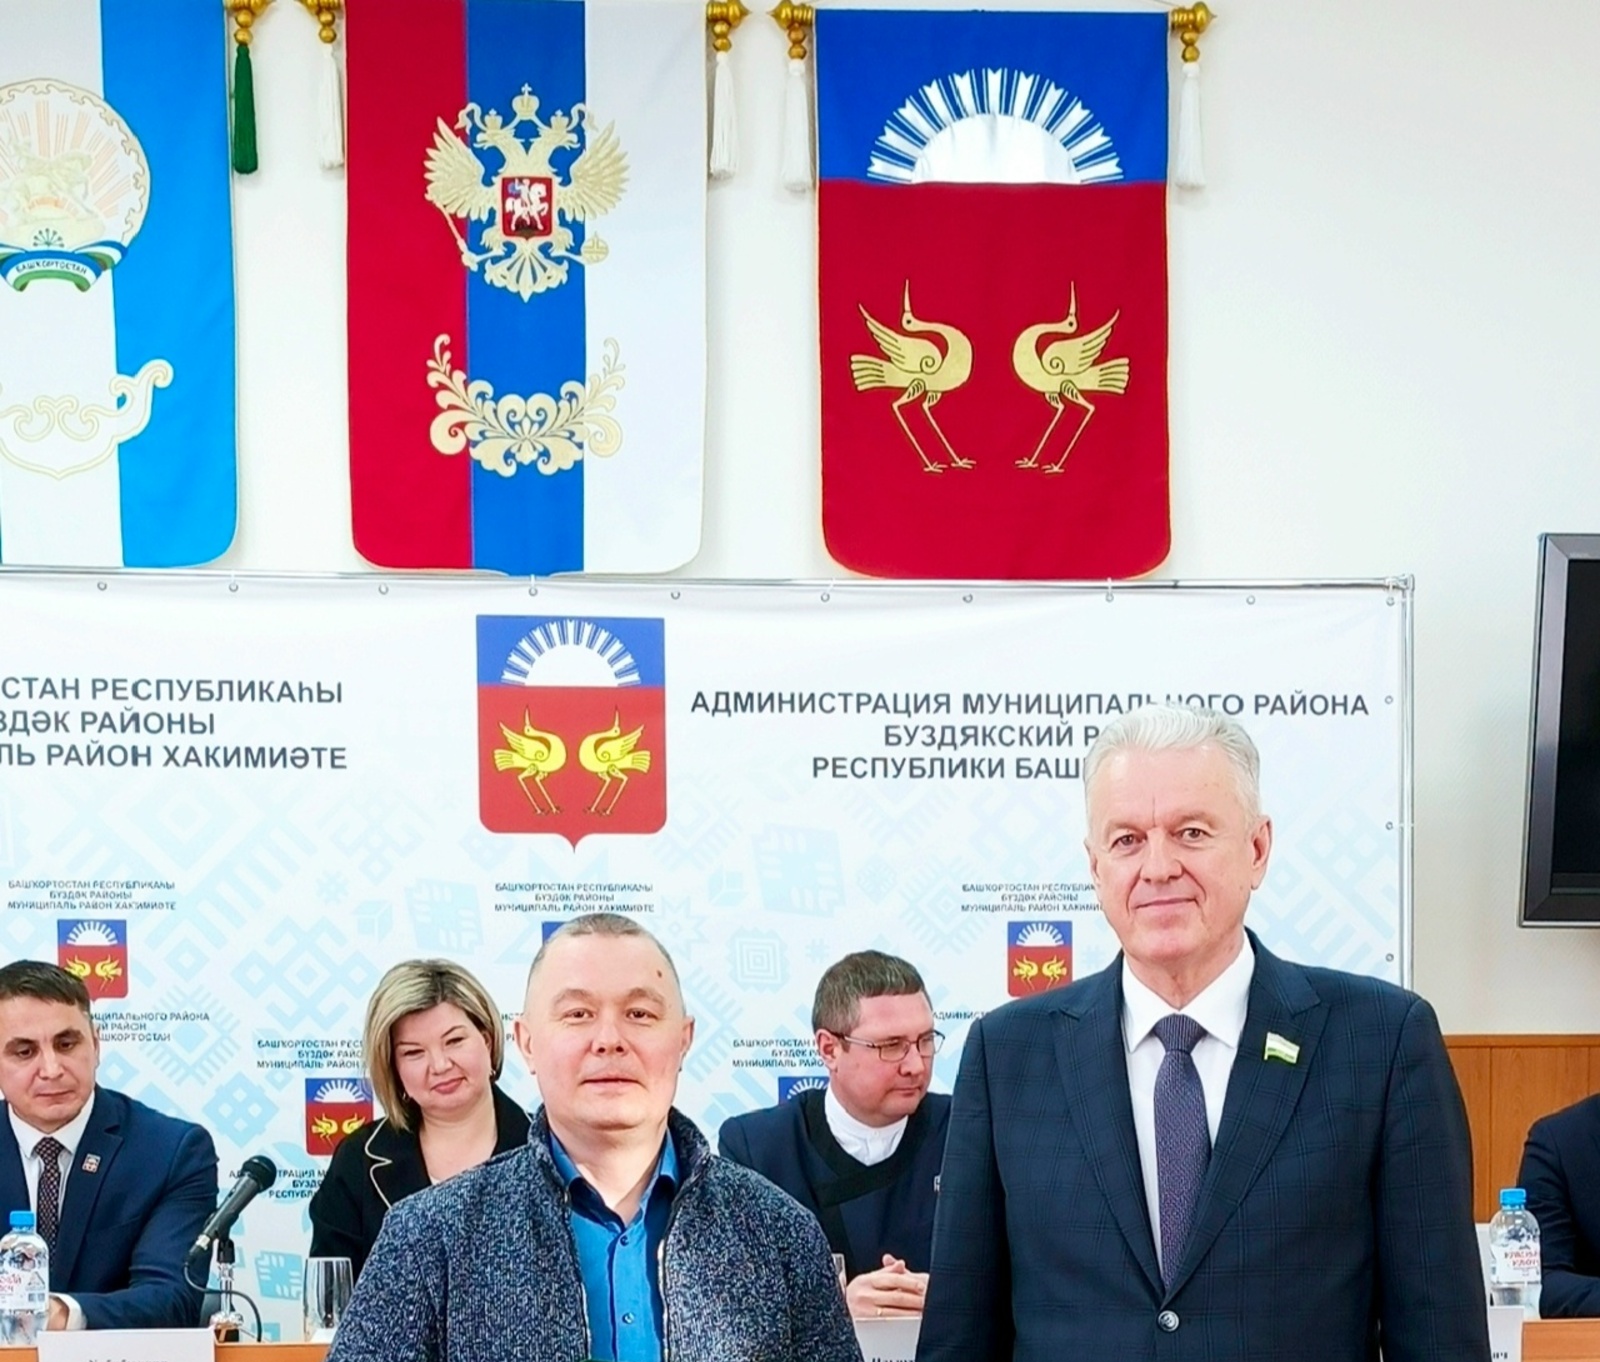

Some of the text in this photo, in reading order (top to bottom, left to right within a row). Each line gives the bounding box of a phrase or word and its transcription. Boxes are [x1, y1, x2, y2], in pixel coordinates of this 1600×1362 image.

[2, 676, 79, 700] СТАН
[691, 691, 950, 718] АДМИНИСТРАЦИЯ
[1254, 690, 1369, 716] РАЙОНА
[81, 706, 214, 734] РАЙОНЫ
[884, 720, 1073, 751] БУЗДЯКСКИЙ
[47, 740, 151, 767] РАЙОН
[162, 745, 347, 769] ХАКИМИӘТЕ
[813, 757, 1085, 779] РЕСПУБЛИКИ БАШ
